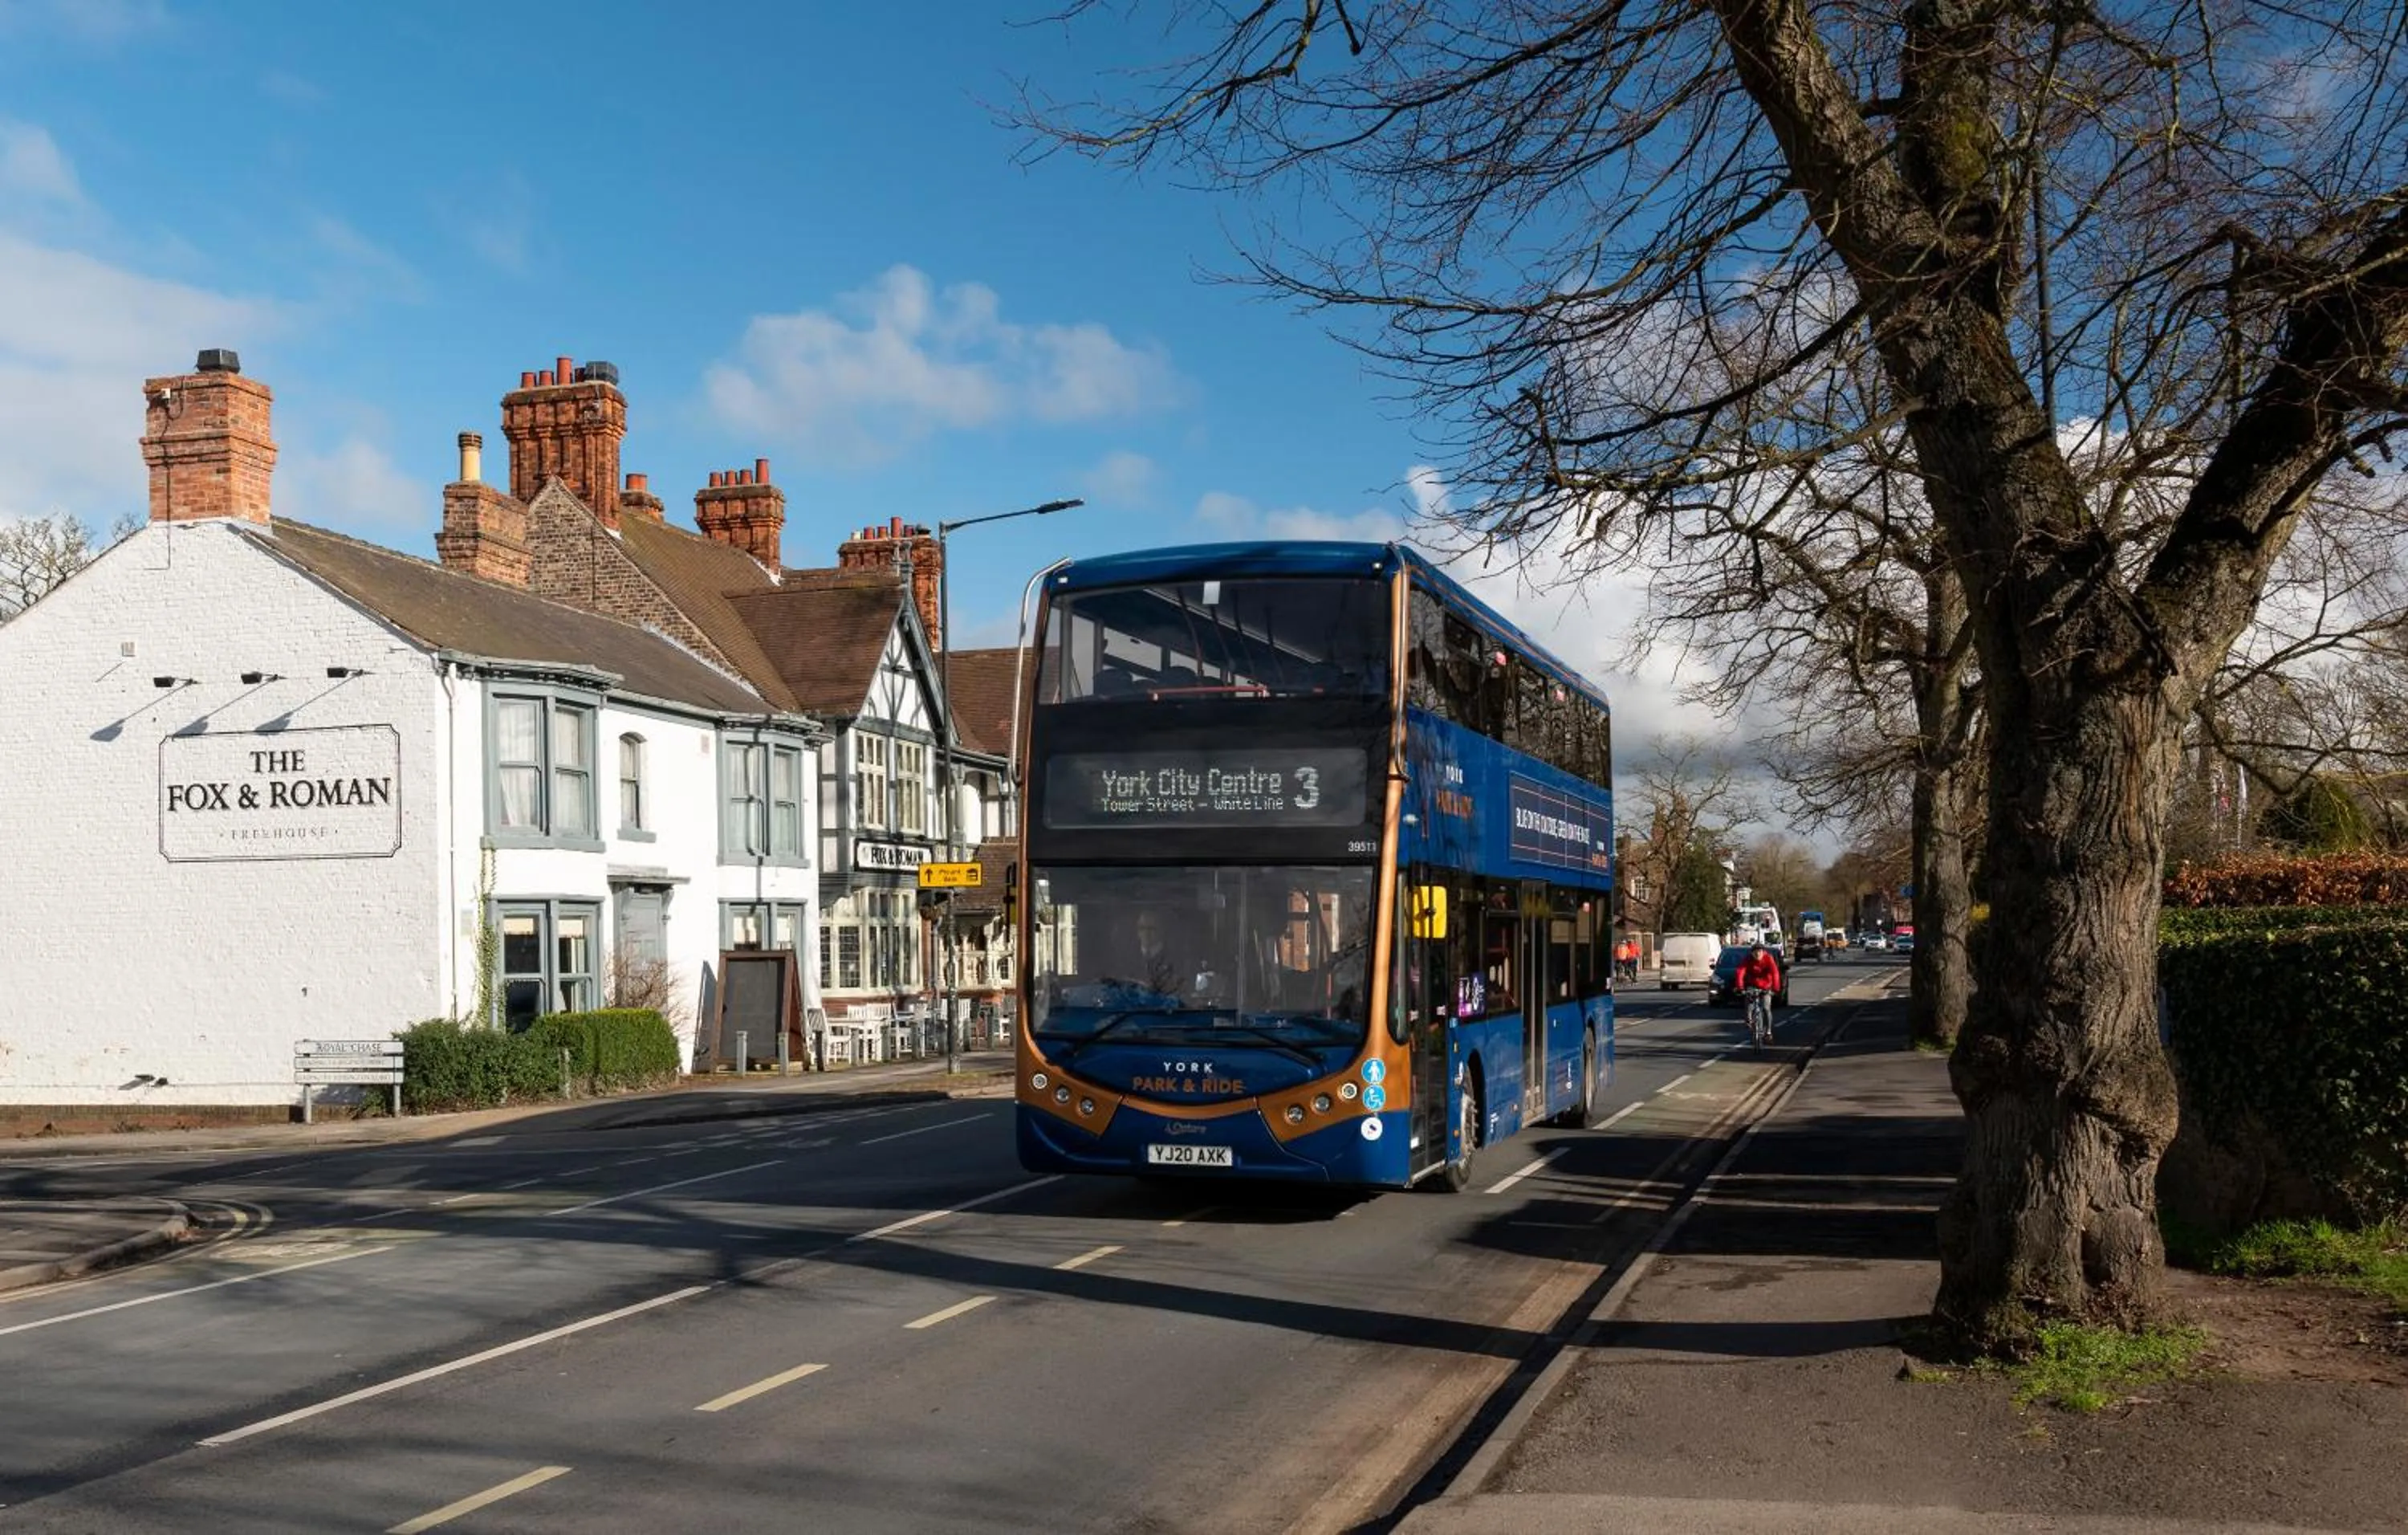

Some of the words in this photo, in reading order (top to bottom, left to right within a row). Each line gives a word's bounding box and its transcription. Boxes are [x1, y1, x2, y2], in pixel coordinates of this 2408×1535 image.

[250, 749, 306, 773] THE
[1101, 770, 1151, 798] York
[1158, 768, 1201, 797] City
[1207, 766, 1283, 796] Centre
[1293, 766, 1320, 809] 3
[167, 783, 230, 812] FOX
[238, 783, 259, 809] &
[269, 777, 391, 808] ROMAN
[1101, 797, 1141, 812] Tower
[1146, 796, 1195, 812] Street
[1254, 795, 1284, 810] Line
[1163, 1061, 1214, 1073] YORK
[1132, 1076, 1178, 1093] PARK
[1182, 1078, 1195, 1093] &
[1202, 1077, 1244, 1094] RIDE
[1155, 1146, 1194, 1162] YJ20
[1197, 1148, 1226, 1164] AXK
